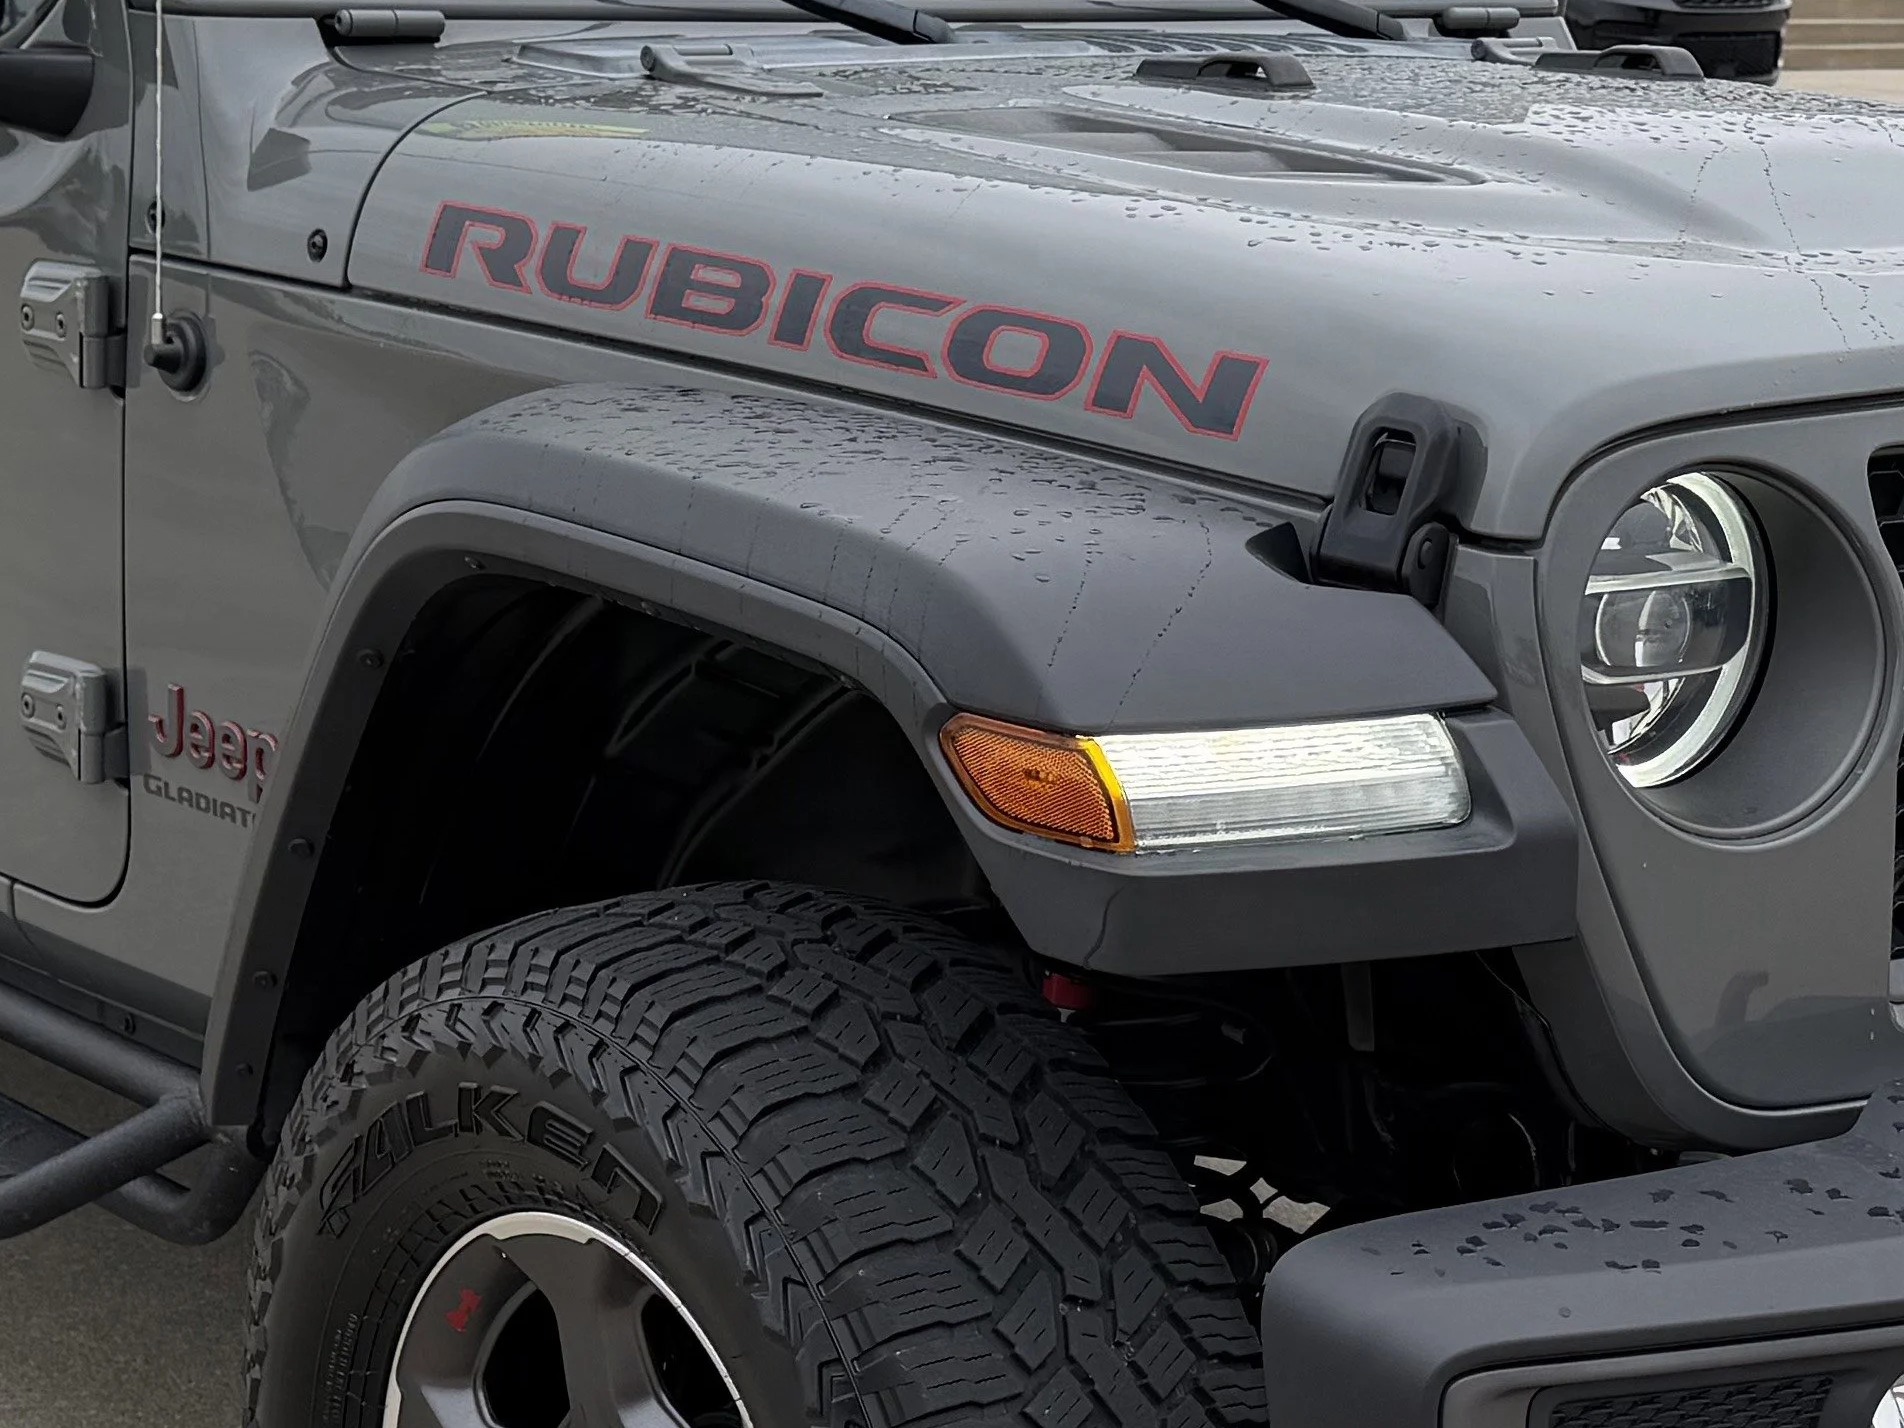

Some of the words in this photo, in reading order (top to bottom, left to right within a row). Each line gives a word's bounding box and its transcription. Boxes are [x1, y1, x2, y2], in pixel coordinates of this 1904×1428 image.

[419, 199, 1271, 442] RUBICON
[142, 772, 257, 829] GLADIAT
[147, 682, 279, 805] Jeep
[318, 1081, 663, 1239] FALKEN
